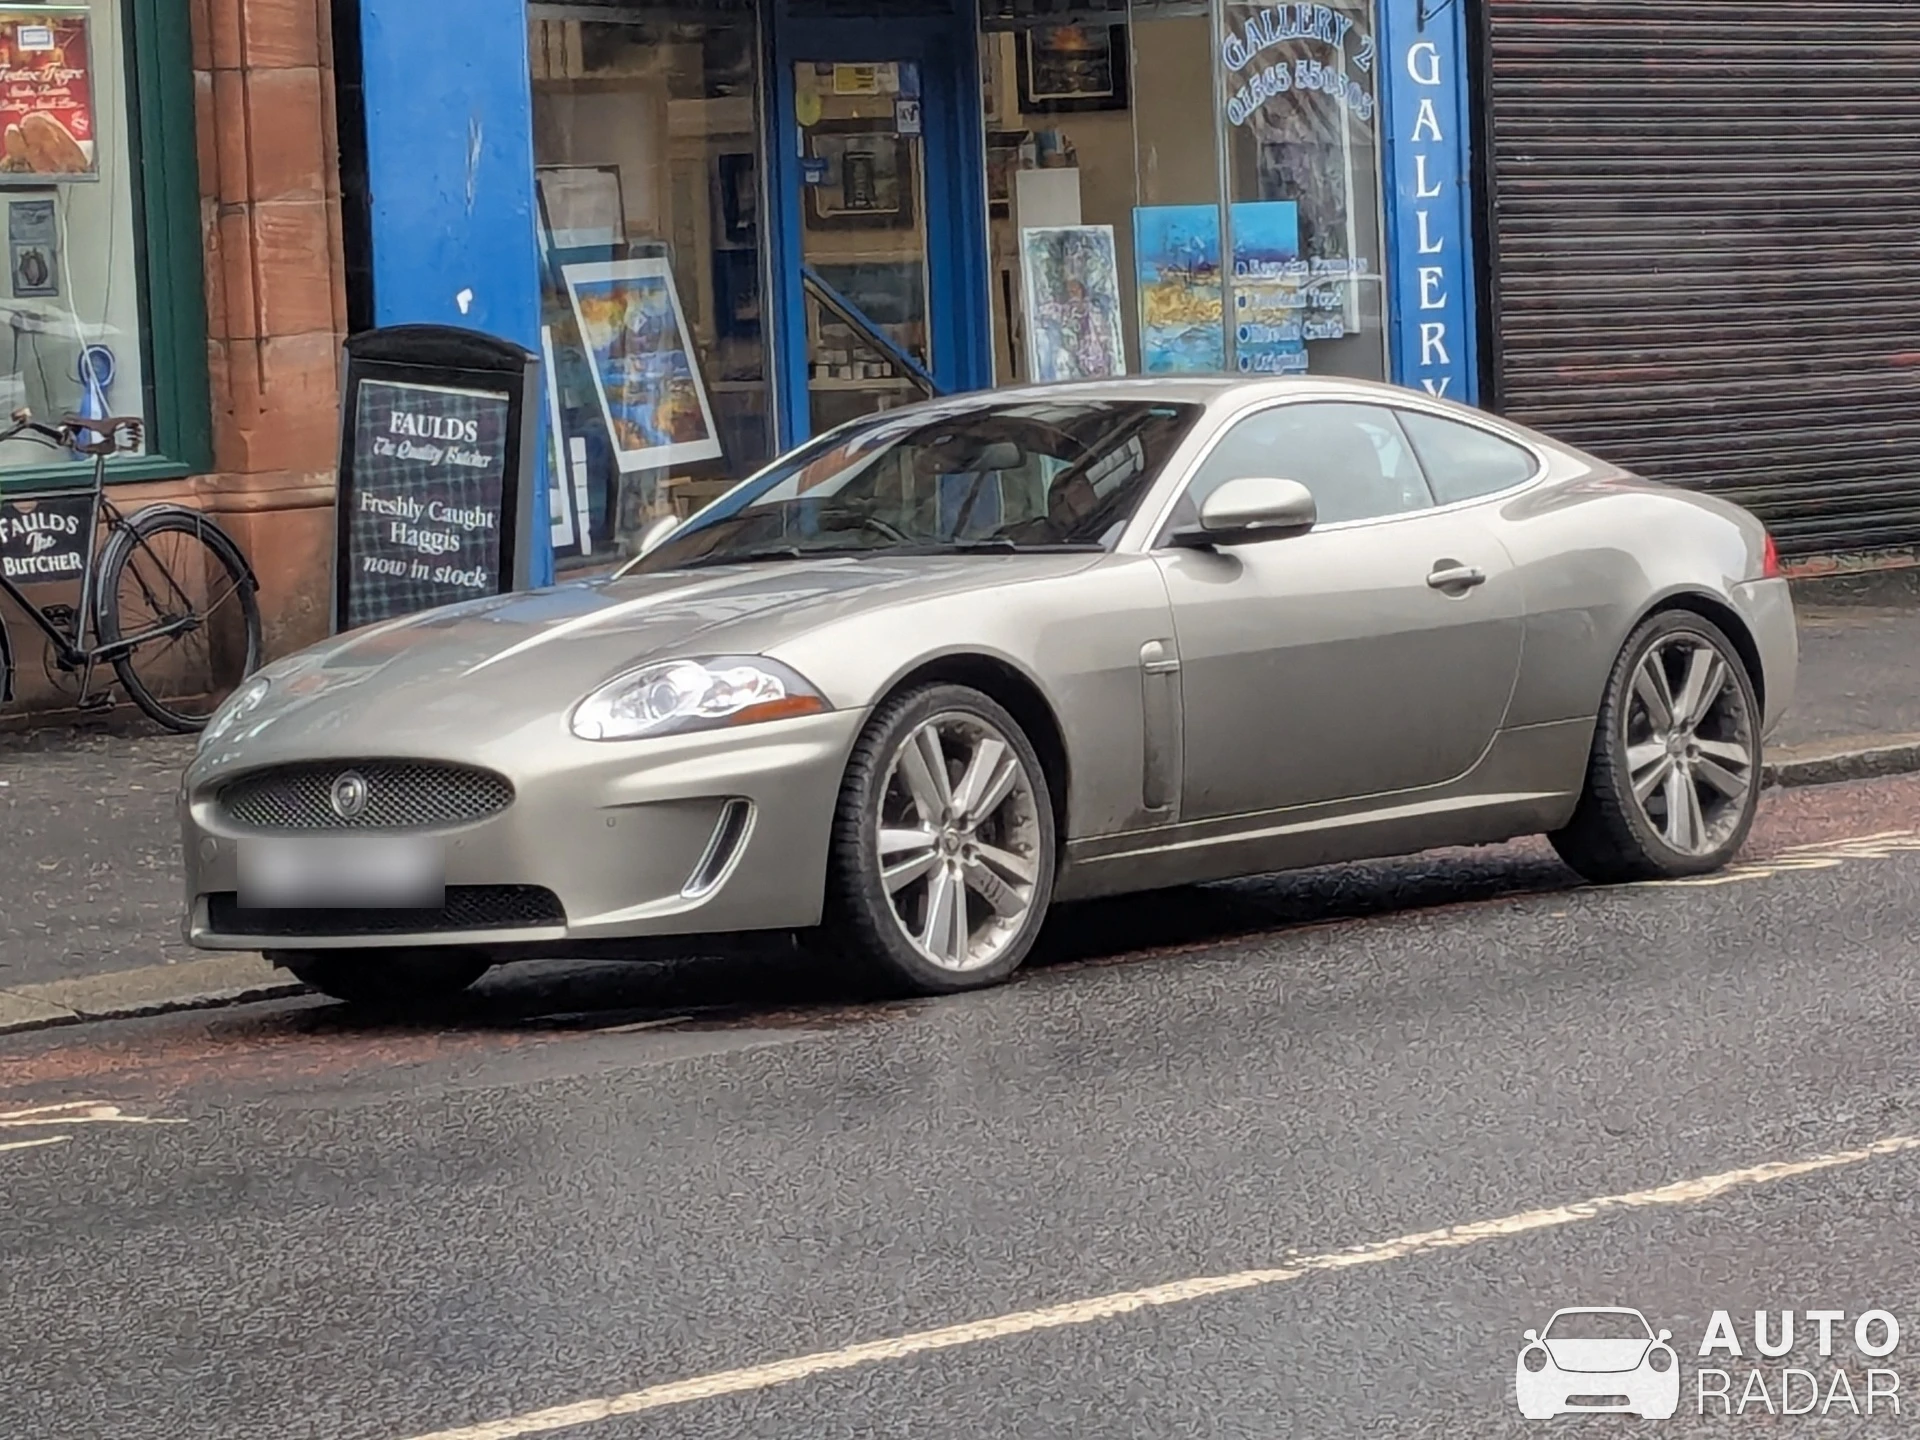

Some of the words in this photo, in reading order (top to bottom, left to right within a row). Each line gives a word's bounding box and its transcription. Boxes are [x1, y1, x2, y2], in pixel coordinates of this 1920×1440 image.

[1223, 2, 1353, 71] GALLERY
[1353, 34, 1376, 73] 2
[389, 411, 479, 443] FAULDS
[396, 440, 445, 466] Quality
[0, 512, 79, 543] FAULDS
[360, 492, 425, 524] Freshly
[428, 501, 494, 531] Caught
[26, 532, 57, 554] The
[389, 521, 461, 556] Haggis
[2, 552, 83, 577] BUTCHER
[363, 556, 408, 577] now
[411, 559, 430, 581] in
[432, 565, 488, 588] stock
